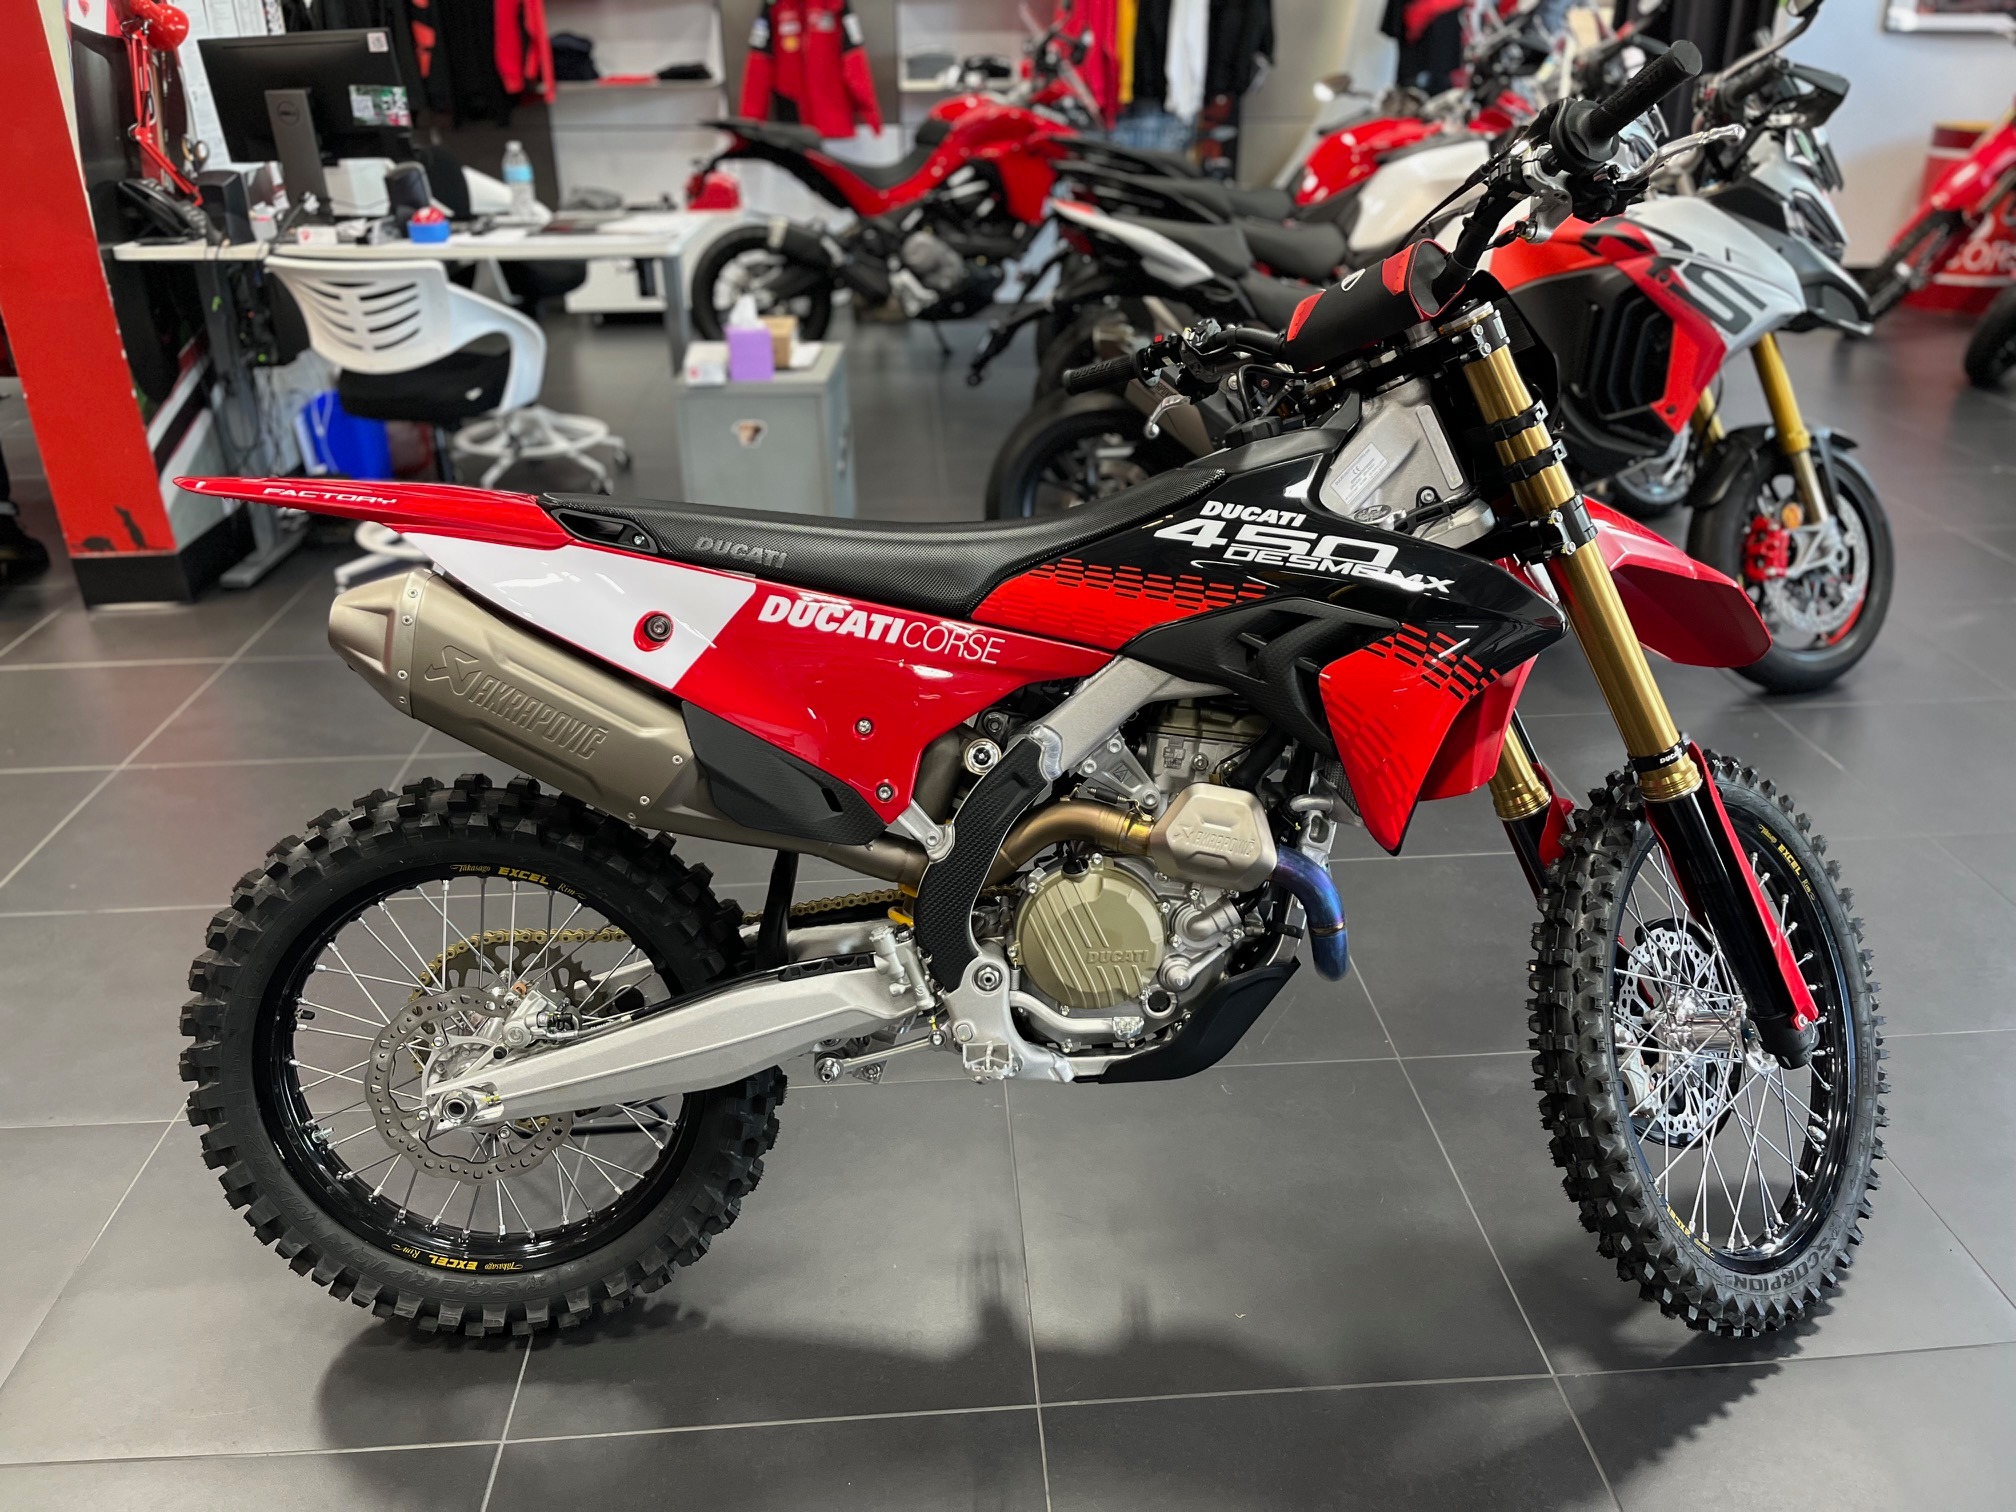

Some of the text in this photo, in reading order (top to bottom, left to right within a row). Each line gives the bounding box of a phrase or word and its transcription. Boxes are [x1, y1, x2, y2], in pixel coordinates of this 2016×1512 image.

[1074, 361, 1112, 379] DUCATI
[263, 488, 397, 504] FACTORY
[1200, 500, 1307, 528] DUCATI
[693, 536, 787, 568] DUCATI
[1154, 518, 1399, 568] 450
[758, 594, 1006, 664] DUCATI CORSE
[1777, 843, 1801, 876] EXCEL
[498, 866, 549, 885] EXCEL
[558, 882, 576, 895] Rim
[1086, 950, 1149, 963] DUCATI
[402, 1246, 421, 1259] Rim
[429, 1254, 478, 1271] EXCEL
[1733, 1237, 1831, 1291] SCORPION
